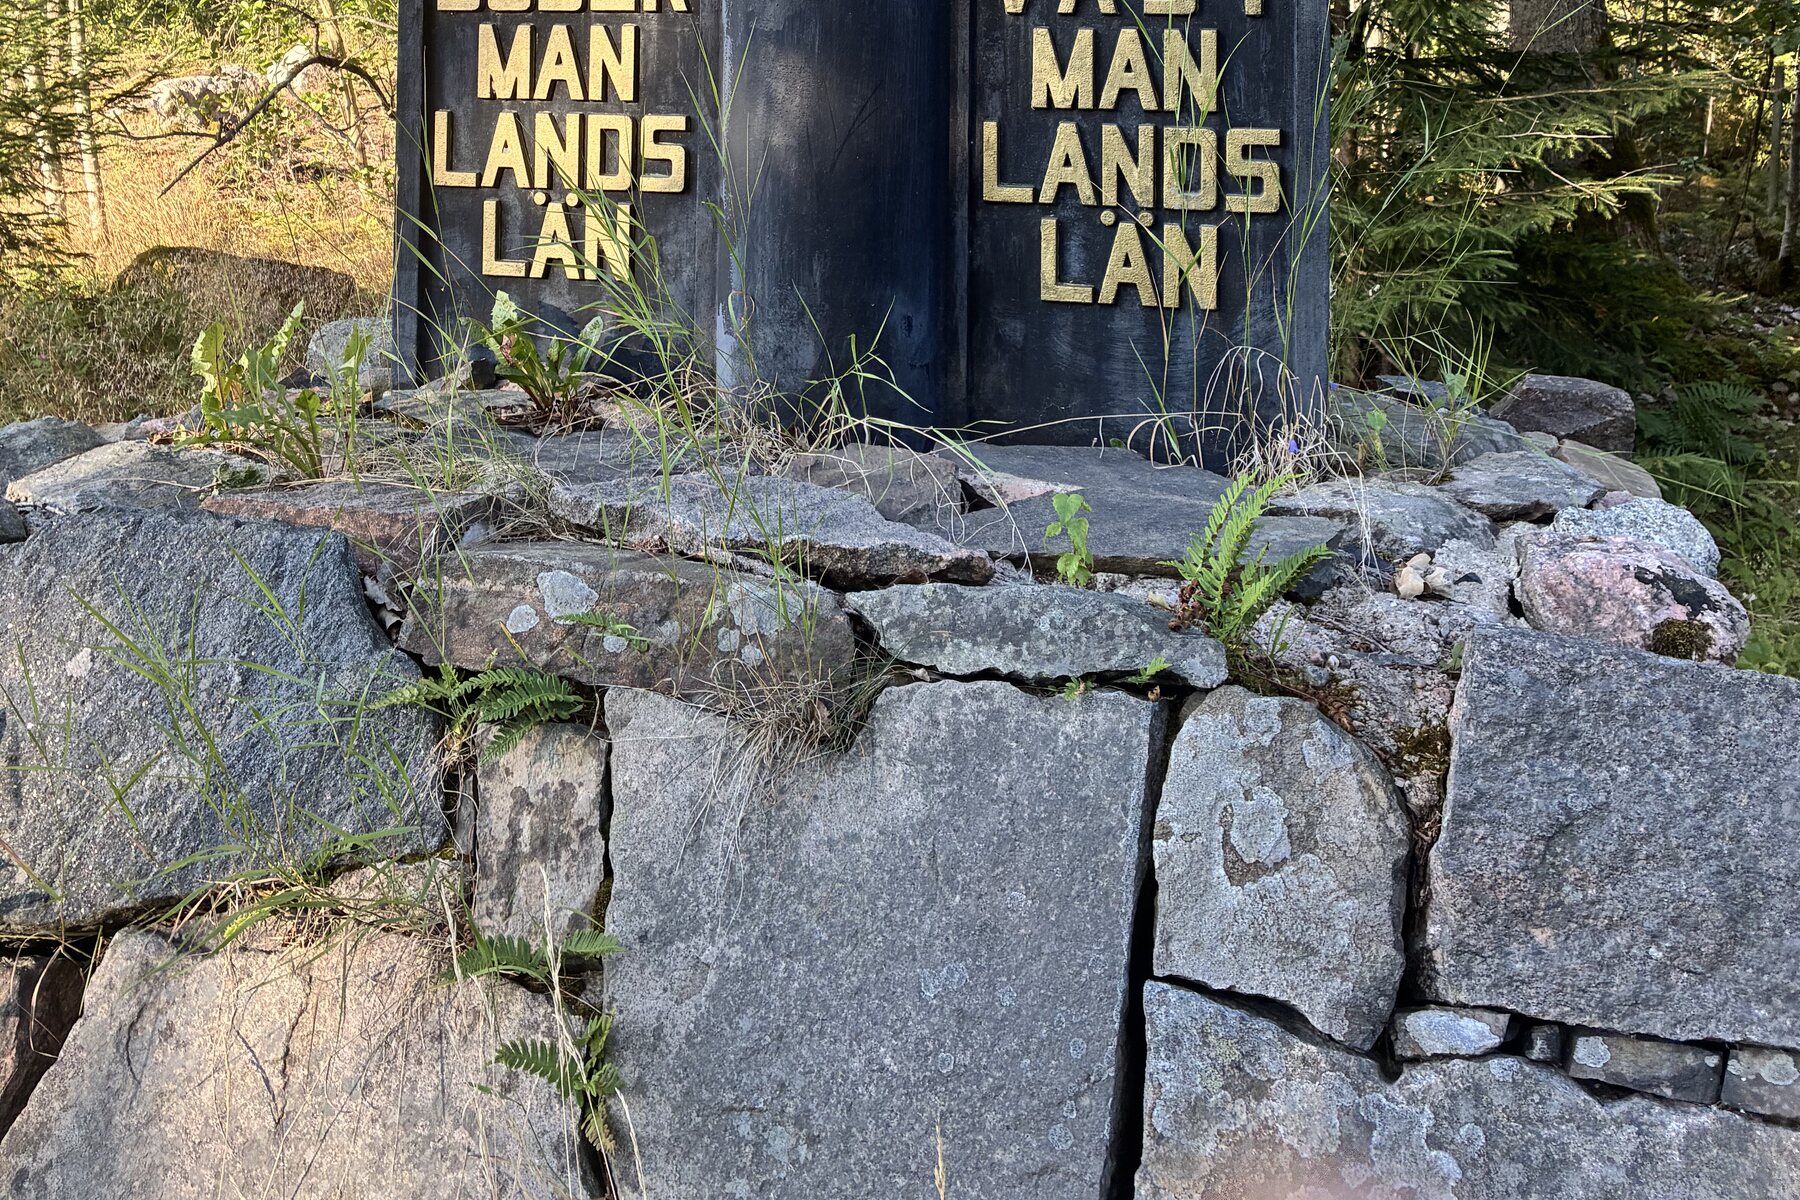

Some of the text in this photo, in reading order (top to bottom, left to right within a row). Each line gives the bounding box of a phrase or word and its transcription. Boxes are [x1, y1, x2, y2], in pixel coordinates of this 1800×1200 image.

[477, 23, 638, 101] MAN
[1031, 27, 1218, 112] MAN
[433, 110, 689, 193] LANDS
[982, 121, 1281, 213] LANDS
[482, 191, 632, 281] LÄN
[1040, 210, 1218, 311] LÄN
